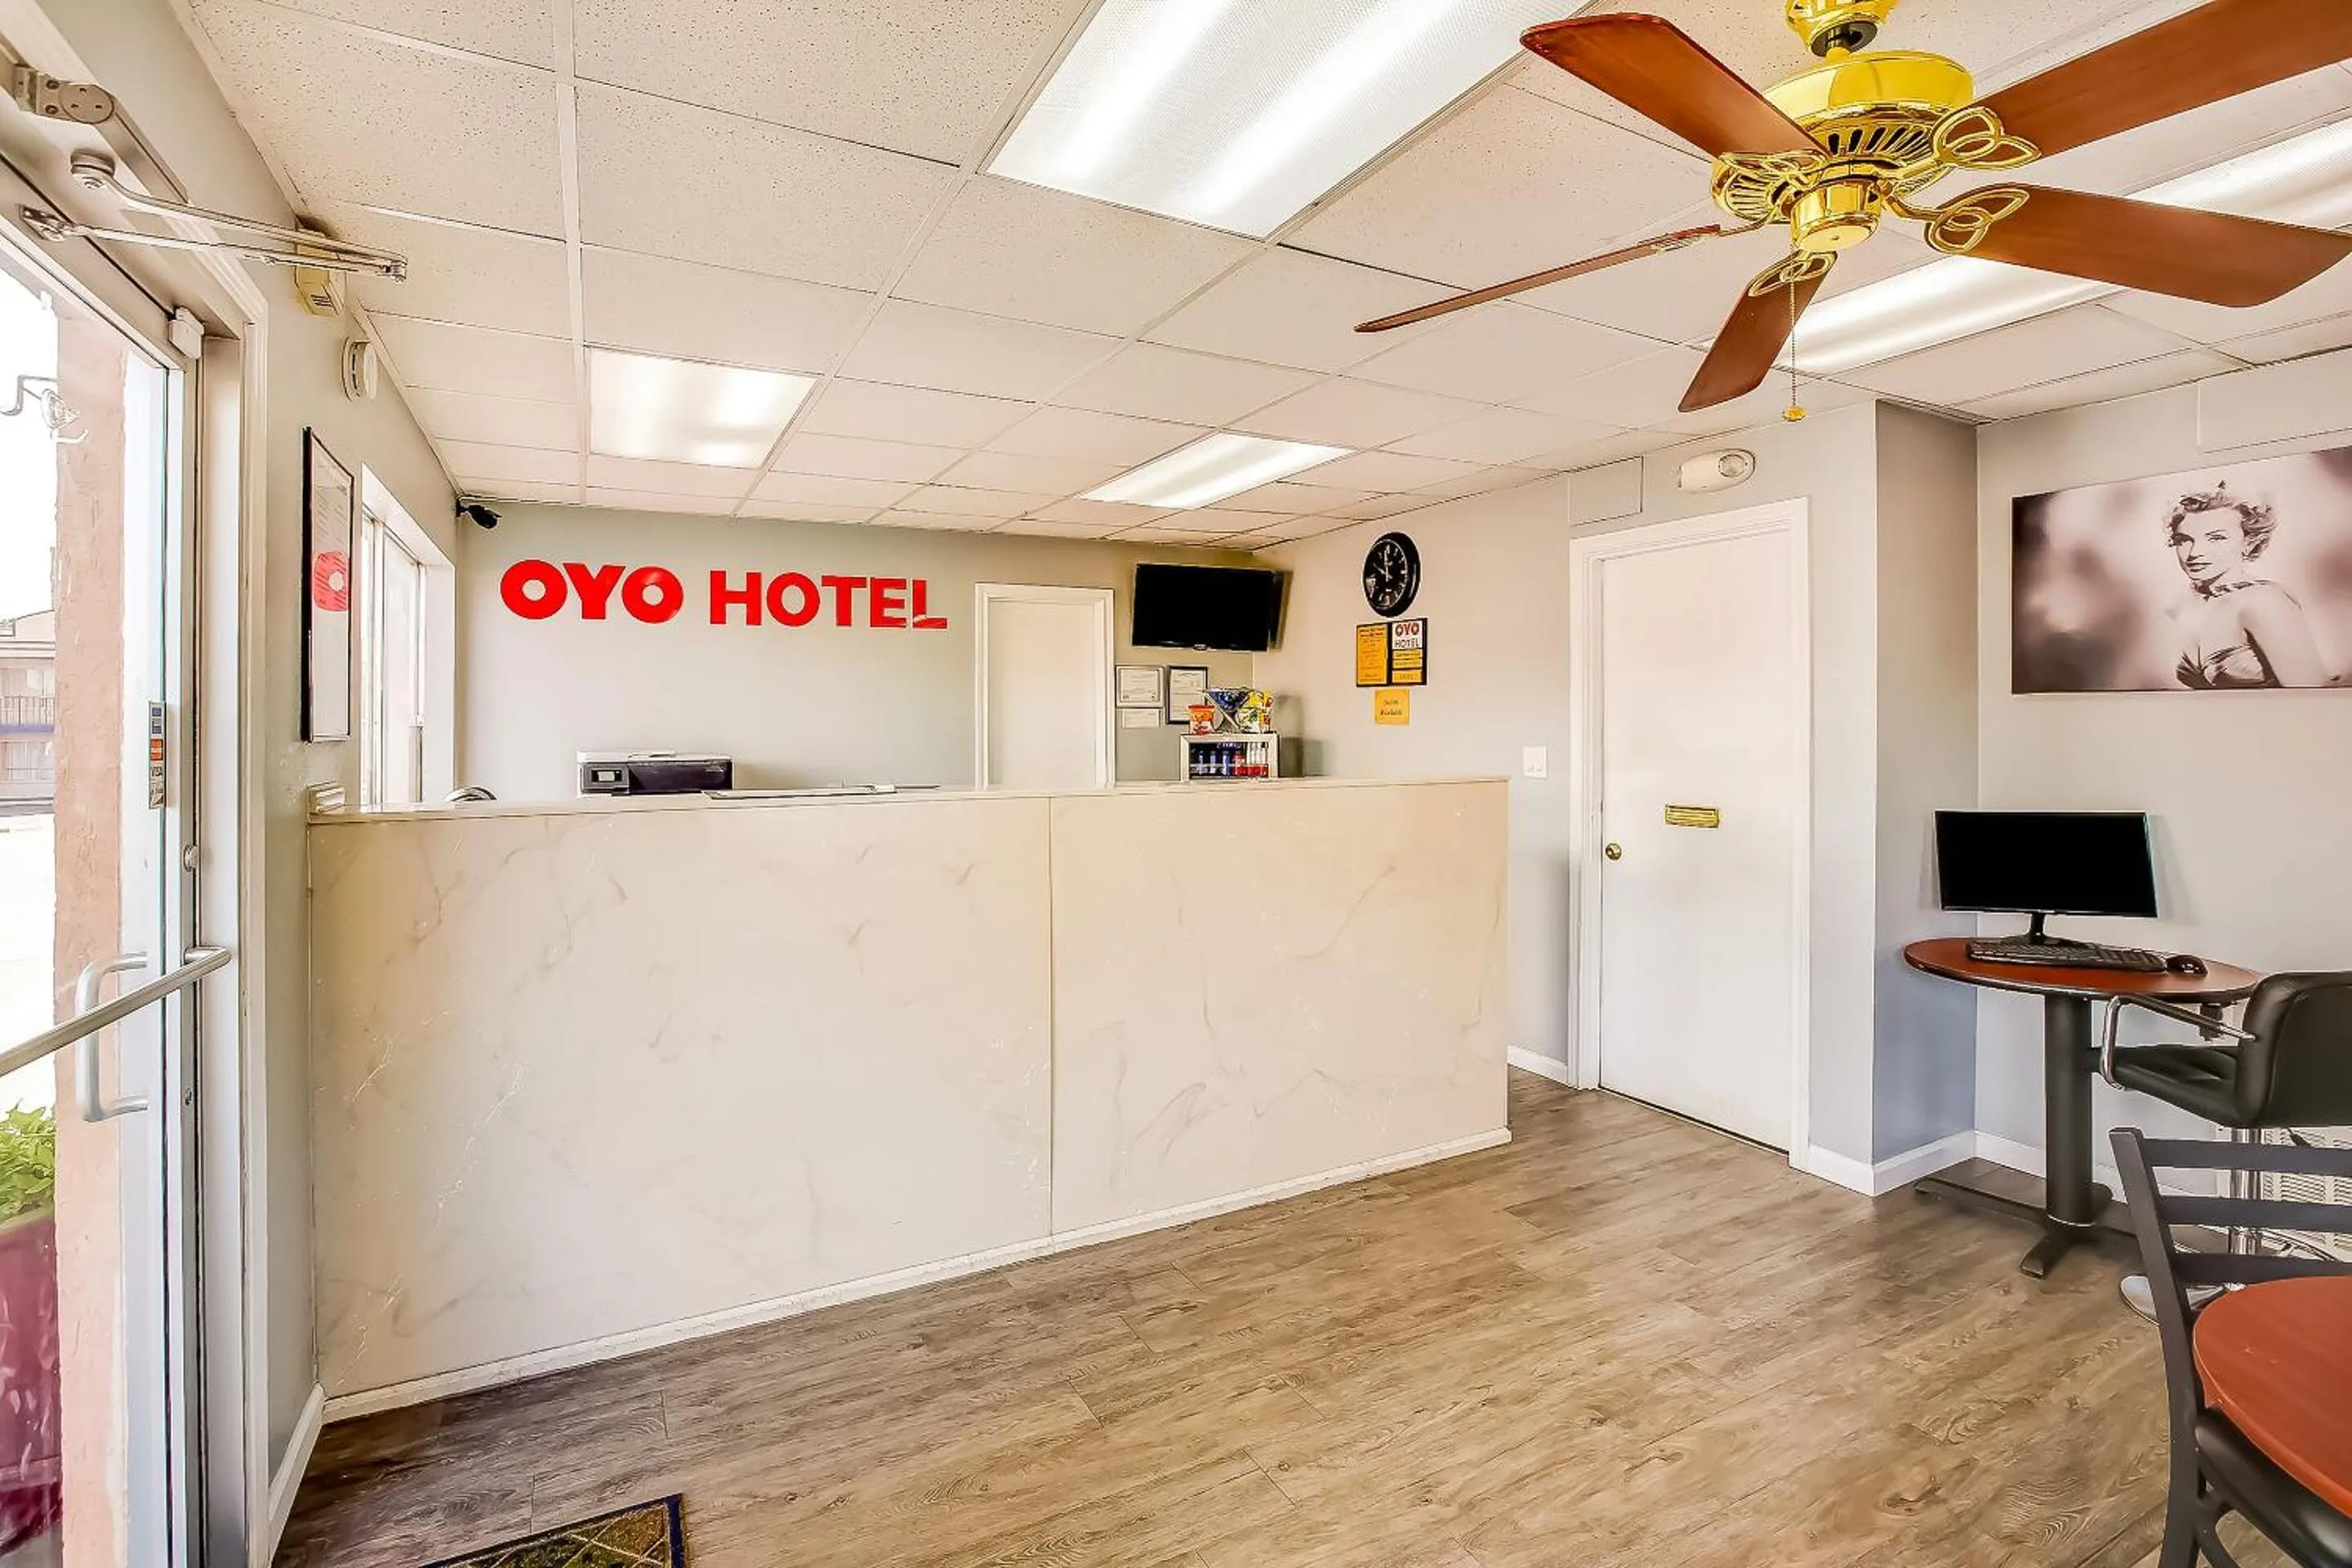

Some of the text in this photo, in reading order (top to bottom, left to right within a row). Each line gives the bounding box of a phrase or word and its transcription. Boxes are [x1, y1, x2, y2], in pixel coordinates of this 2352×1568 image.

[500, 559, 948, 630] OYO HOTEL
[1395, 622, 1419, 636] OYO
[1394, 638, 1419, 648] HOTEL
